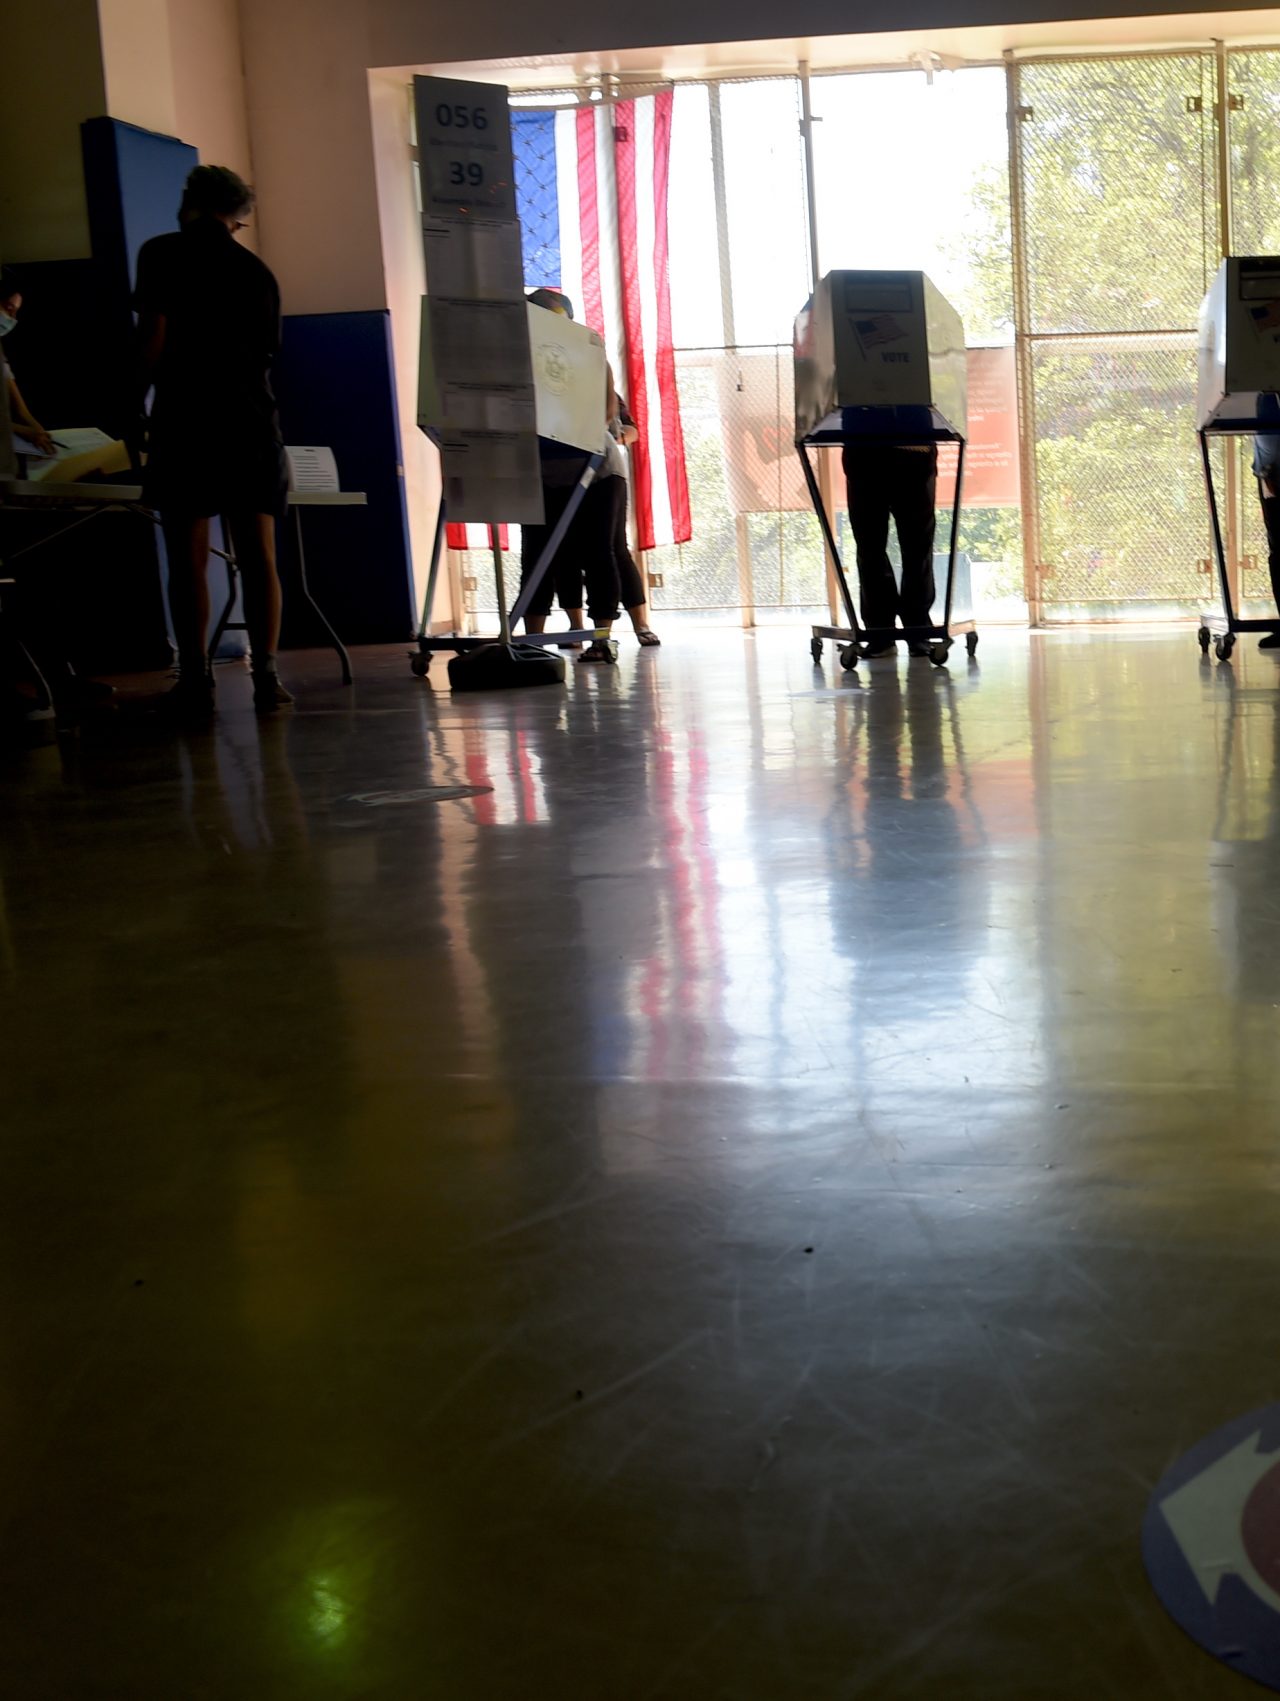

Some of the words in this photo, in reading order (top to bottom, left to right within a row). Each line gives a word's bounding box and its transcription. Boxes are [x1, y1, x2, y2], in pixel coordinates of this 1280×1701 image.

[435, 103, 488, 130] 056
[449, 161, 484, 187] 39
[881, 351, 910, 363] VOTE
